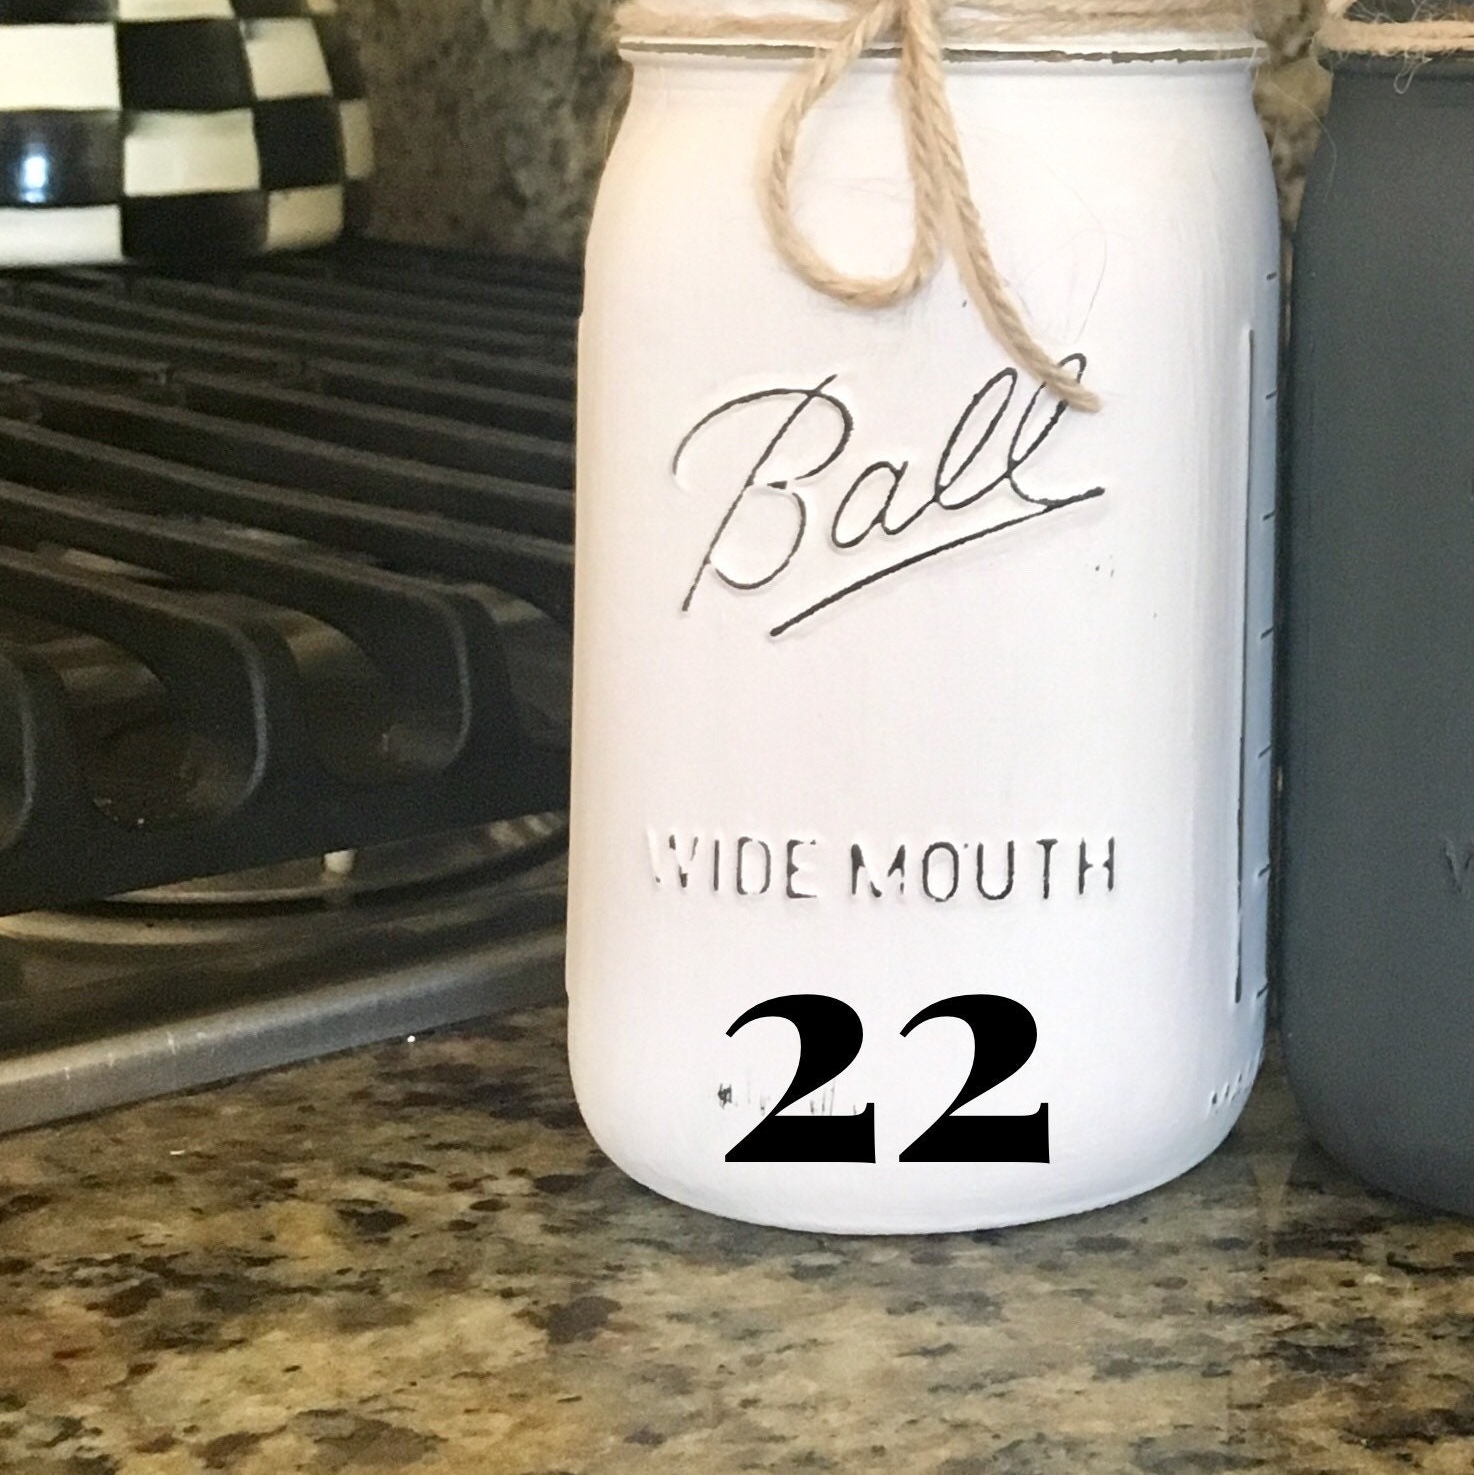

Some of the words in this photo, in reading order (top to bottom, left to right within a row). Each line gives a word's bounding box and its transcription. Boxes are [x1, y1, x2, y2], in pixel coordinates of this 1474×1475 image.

[672, 352, 1105, 613] Ball
[647, 829, 818, 899] WIDE
[850, 834, 1116, 902] MOUTH
